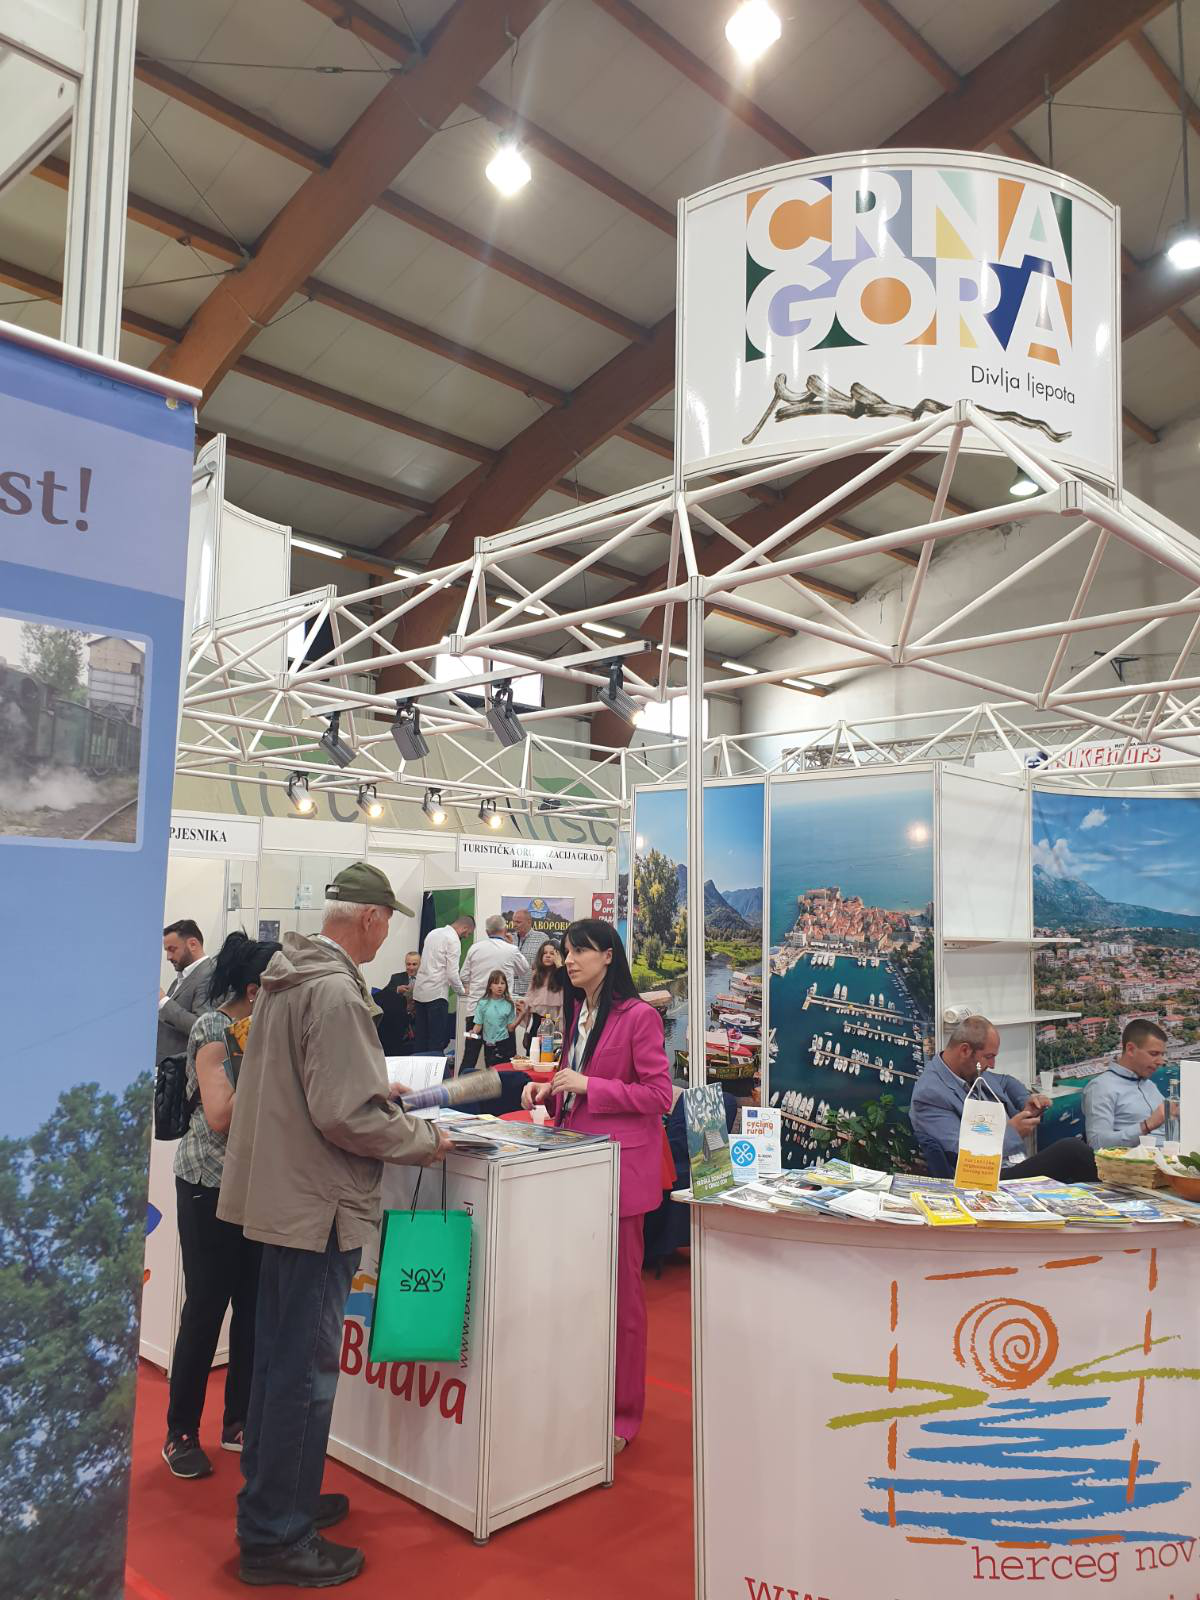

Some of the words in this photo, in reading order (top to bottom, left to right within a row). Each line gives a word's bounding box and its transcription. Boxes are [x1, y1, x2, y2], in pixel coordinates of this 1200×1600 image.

[746, 169, 1072, 284] CRNA
[746, 256, 1072, 365] GORA
[970, 365, 1020, 394] Divlja
[1026, 373, 1076, 405] ljepota
[0, 467, 92, 531] st!
[462, 842, 515, 856] TURISTIČKA
[516, 847, 577, 861] ORGZACIJA
[577, 851, 604, 862] GRADA
[511, 859, 553, 870] BIJELJINA
[746, 1120, 774, 1130] cycling
[971, 1546, 1119, 1582] herceg
[1135, 1537, 1200, 1571] nov
